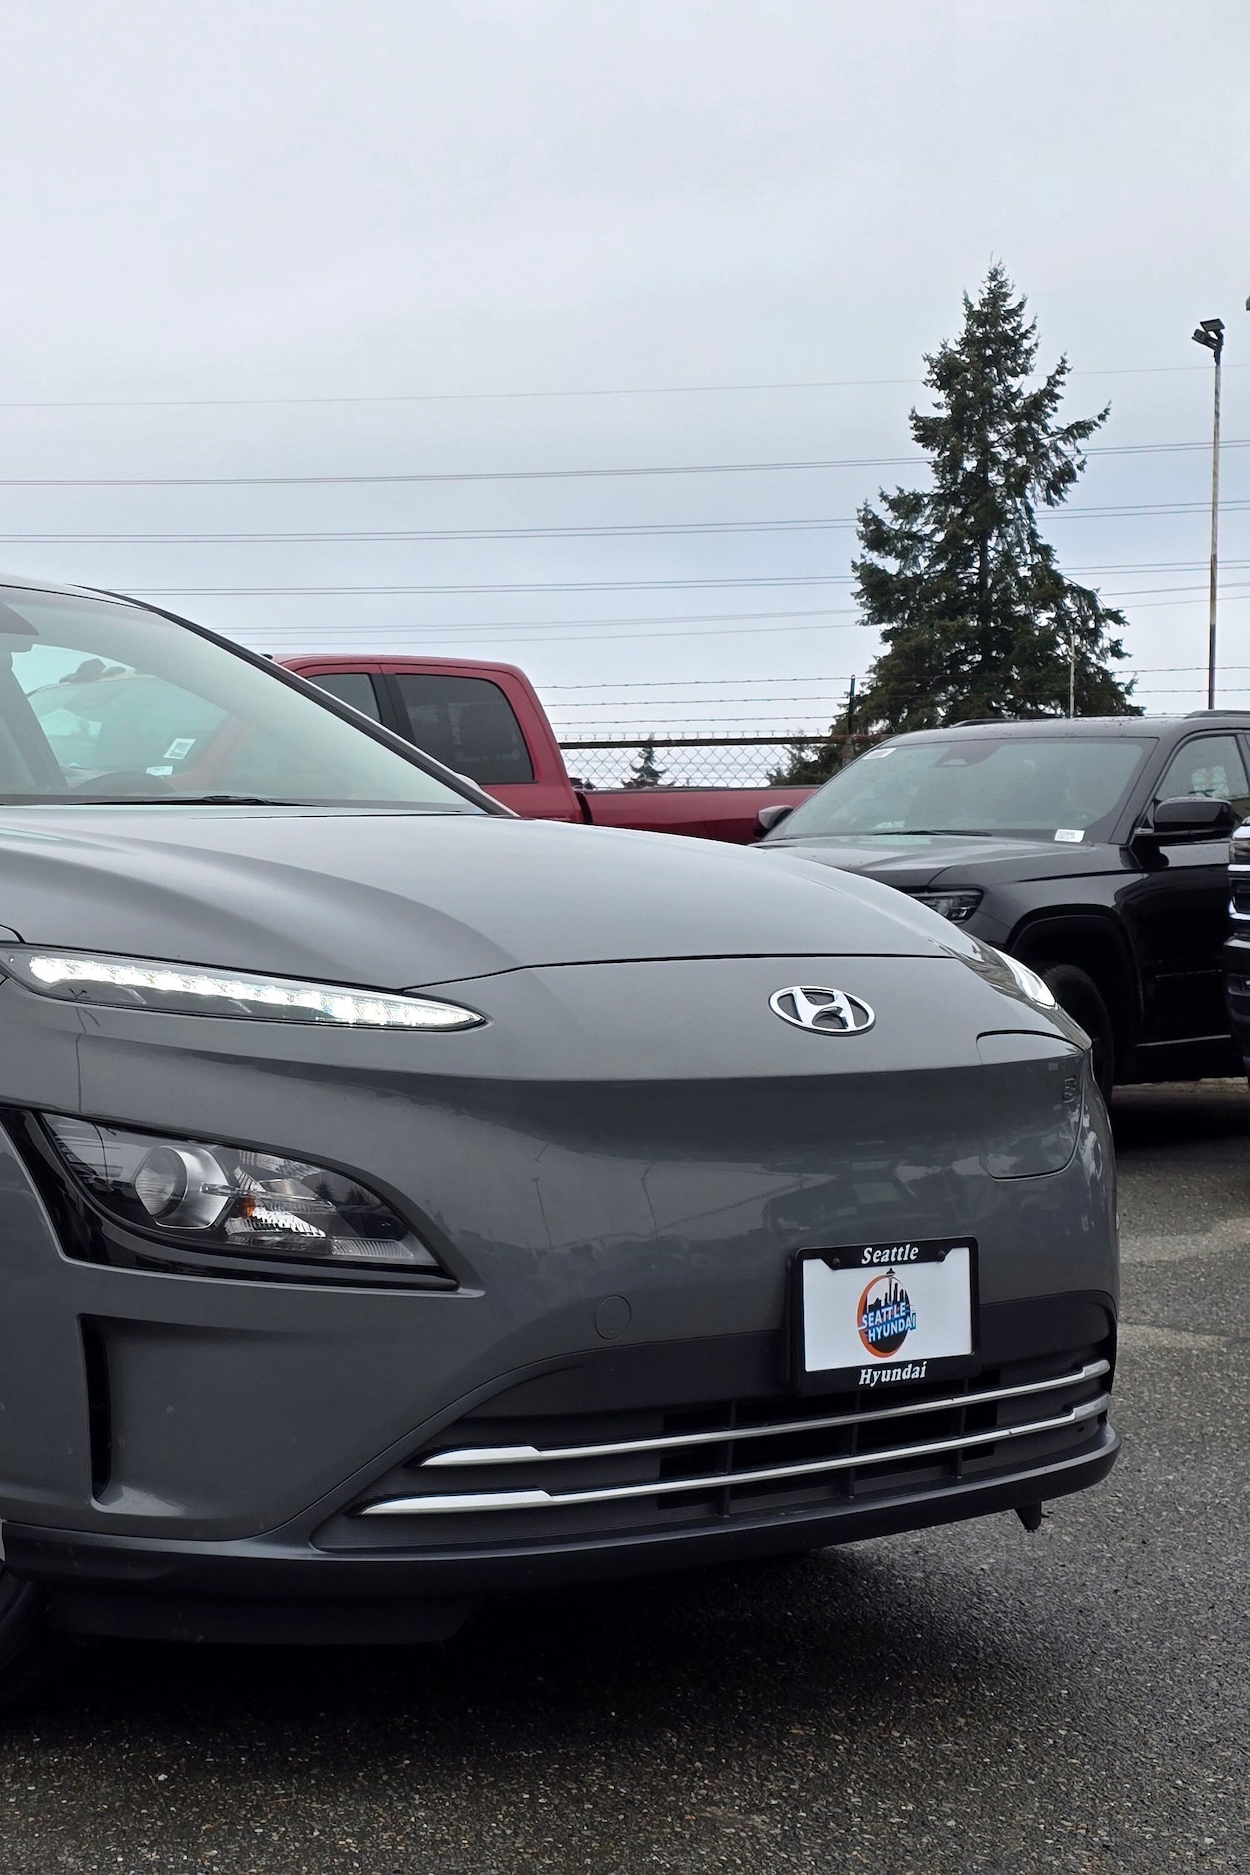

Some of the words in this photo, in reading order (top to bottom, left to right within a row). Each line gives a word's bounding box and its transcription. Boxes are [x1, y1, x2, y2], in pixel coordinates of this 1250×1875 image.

[861, 1244, 919, 1264] Seattle
[862, 1302, 906, 1329] SEATTLE
[868, 1313, 916, 1342] HYUNDAI
[858, 1361, 927, 1387] Hyundai
